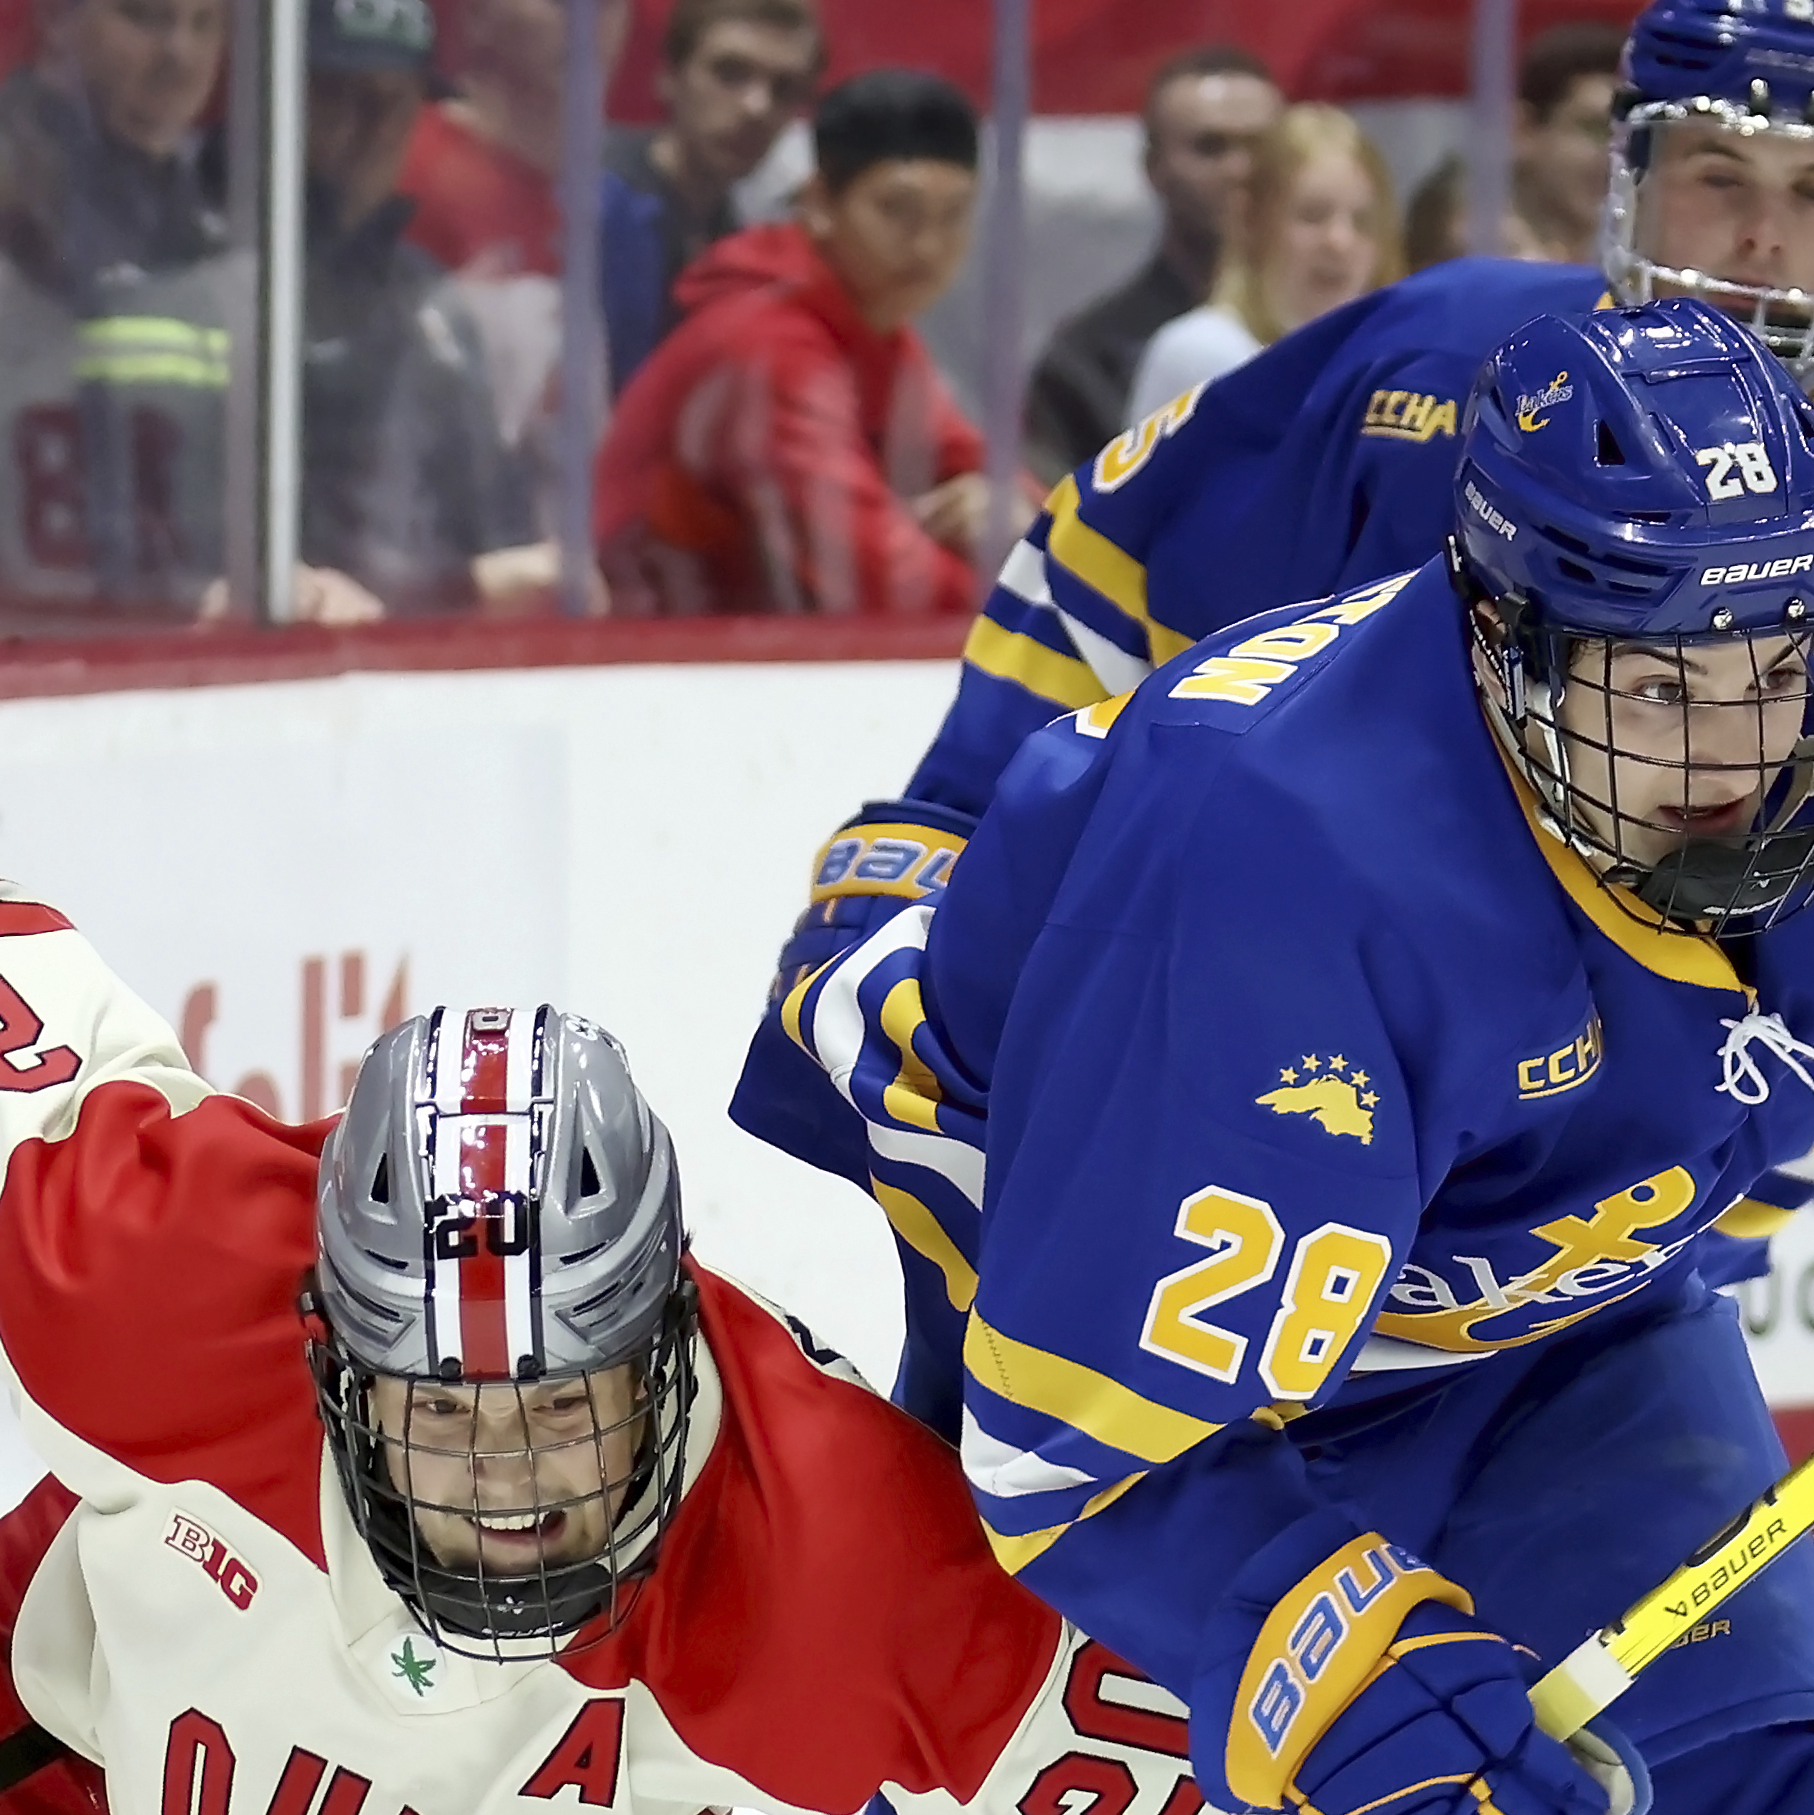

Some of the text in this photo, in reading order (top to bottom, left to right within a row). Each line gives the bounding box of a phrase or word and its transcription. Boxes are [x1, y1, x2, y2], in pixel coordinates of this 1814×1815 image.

[1362, 389, 1458, 442] CCHA
[1694, 440, 1779, 502] 28
[1699, 552, 1814, 588] BAUER
[431, 1189, 530, 1261] 20
[1139, 1184, 1393, 1401] 28
[519, 1696, 627, 1808] A
